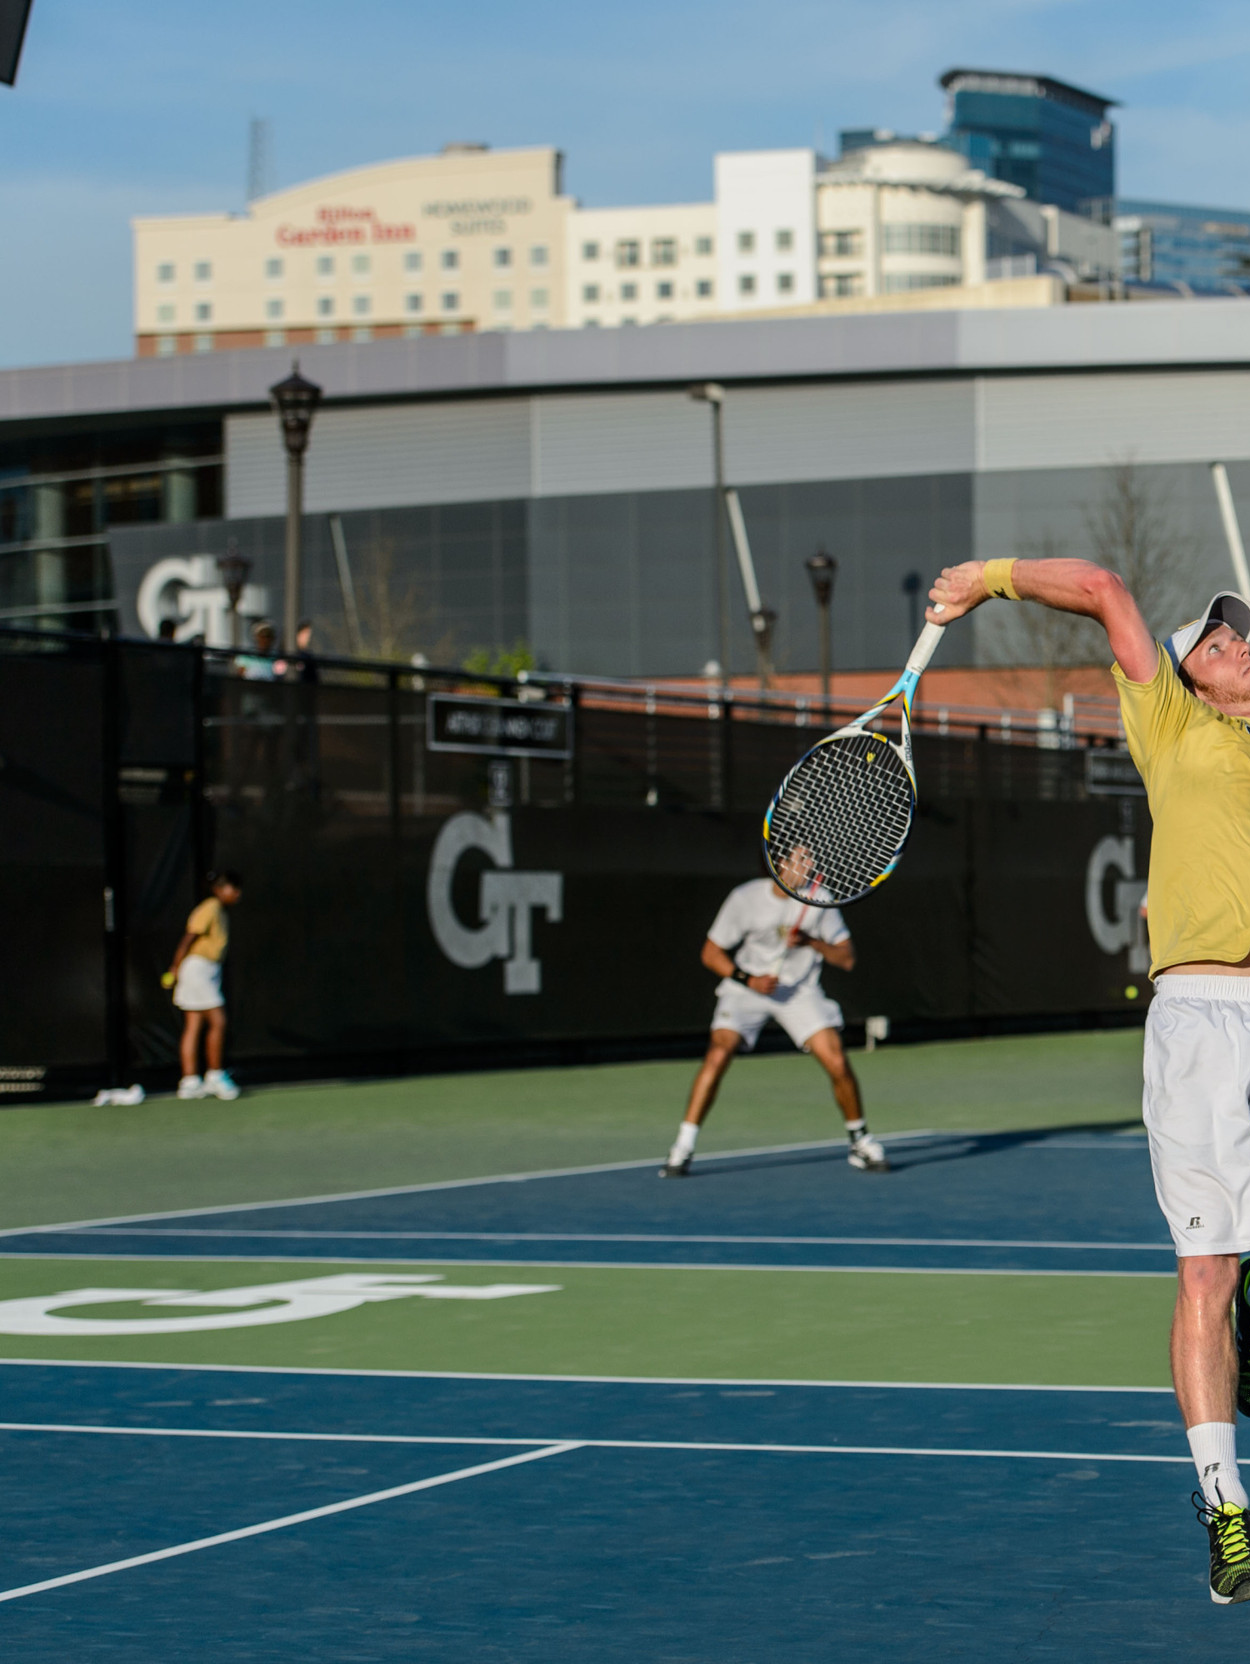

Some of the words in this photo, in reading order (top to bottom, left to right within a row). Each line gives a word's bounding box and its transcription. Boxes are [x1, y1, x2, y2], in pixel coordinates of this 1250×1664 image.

[318, 207, 373, 222] Hilton
[278, 224, 366, 247] Garden
[371, 222, 416, 244] Inn
[428, 811, 563, 995] GT
